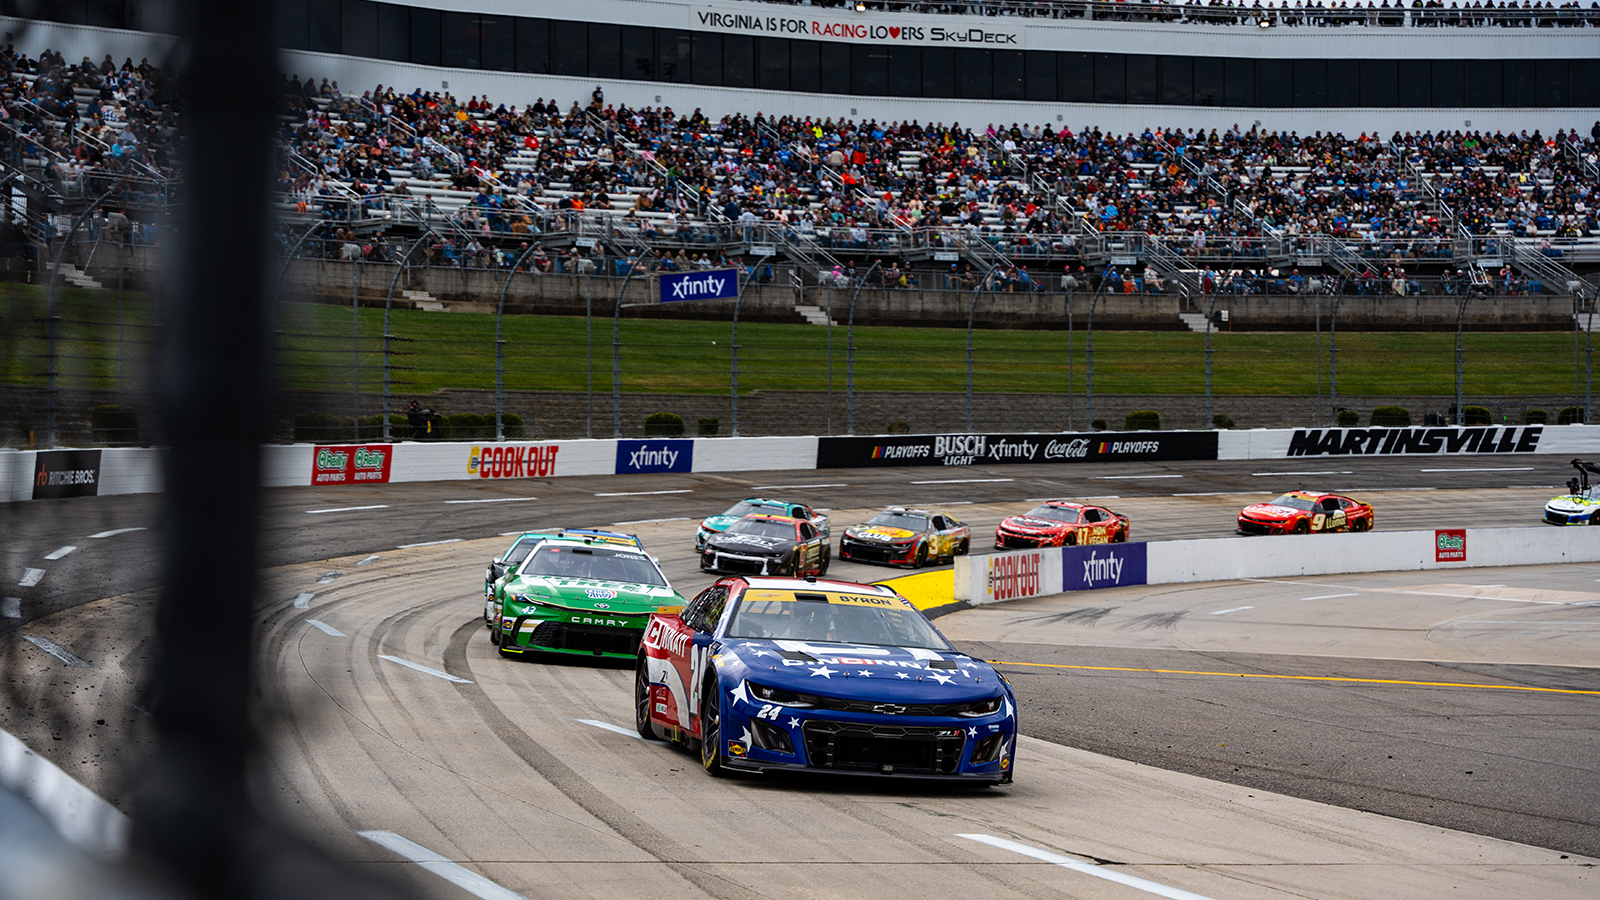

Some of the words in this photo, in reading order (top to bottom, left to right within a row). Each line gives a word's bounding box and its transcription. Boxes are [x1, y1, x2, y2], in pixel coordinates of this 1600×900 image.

[698, 11, 763, 30] VIRGINIA
[766, 17, 777, 31] IS
[780, 18, 809, 34] FOR
[812, 21, 867, 38] RACING
[672, 275, 725, 299] xfinity
[934, 435, 987, 457] BUSCH
[988, 438, 1039, 461] xfinity
[1111, 441, 1159, 454] PLAYOFFS
[1286, 427, 1543, 456] MARTINSVILLE
[628, 444, 679, 470] xfinity
[884, 445, 930, 459] PLAYOFFS
[480, 446, 526, 478] COOK
[527, 445, 559, 477] OUT
[944, 456, 974, 466] LIGHT
[48, 470, 75, 485] RITCHIE
[316, 473, 329, 482] AUTO
[330, 473, 346, 482] PARTS
[354, 472, 366, 480] AUTO
[367, 471, 382, 480] PARTS
[1311, 513, 1326, 530] 9
[857, 531, 892, 542] CLUB
[929, 534, 938, 555] 3
[1077, 527, 1088, 545] 47
[613, 553, 647, 561] JONES
[994, 555, 1020, 600] COOK
[1020, 553, 1040, 597] OUT
[1083, 550, 1123, 587] xfinity
[839, 595, 892, 606] BYRON
[521, 606, 536, 614] 43
[571, 616, 629, 627] CAMRY
[756, 704, 783, 721] 24
